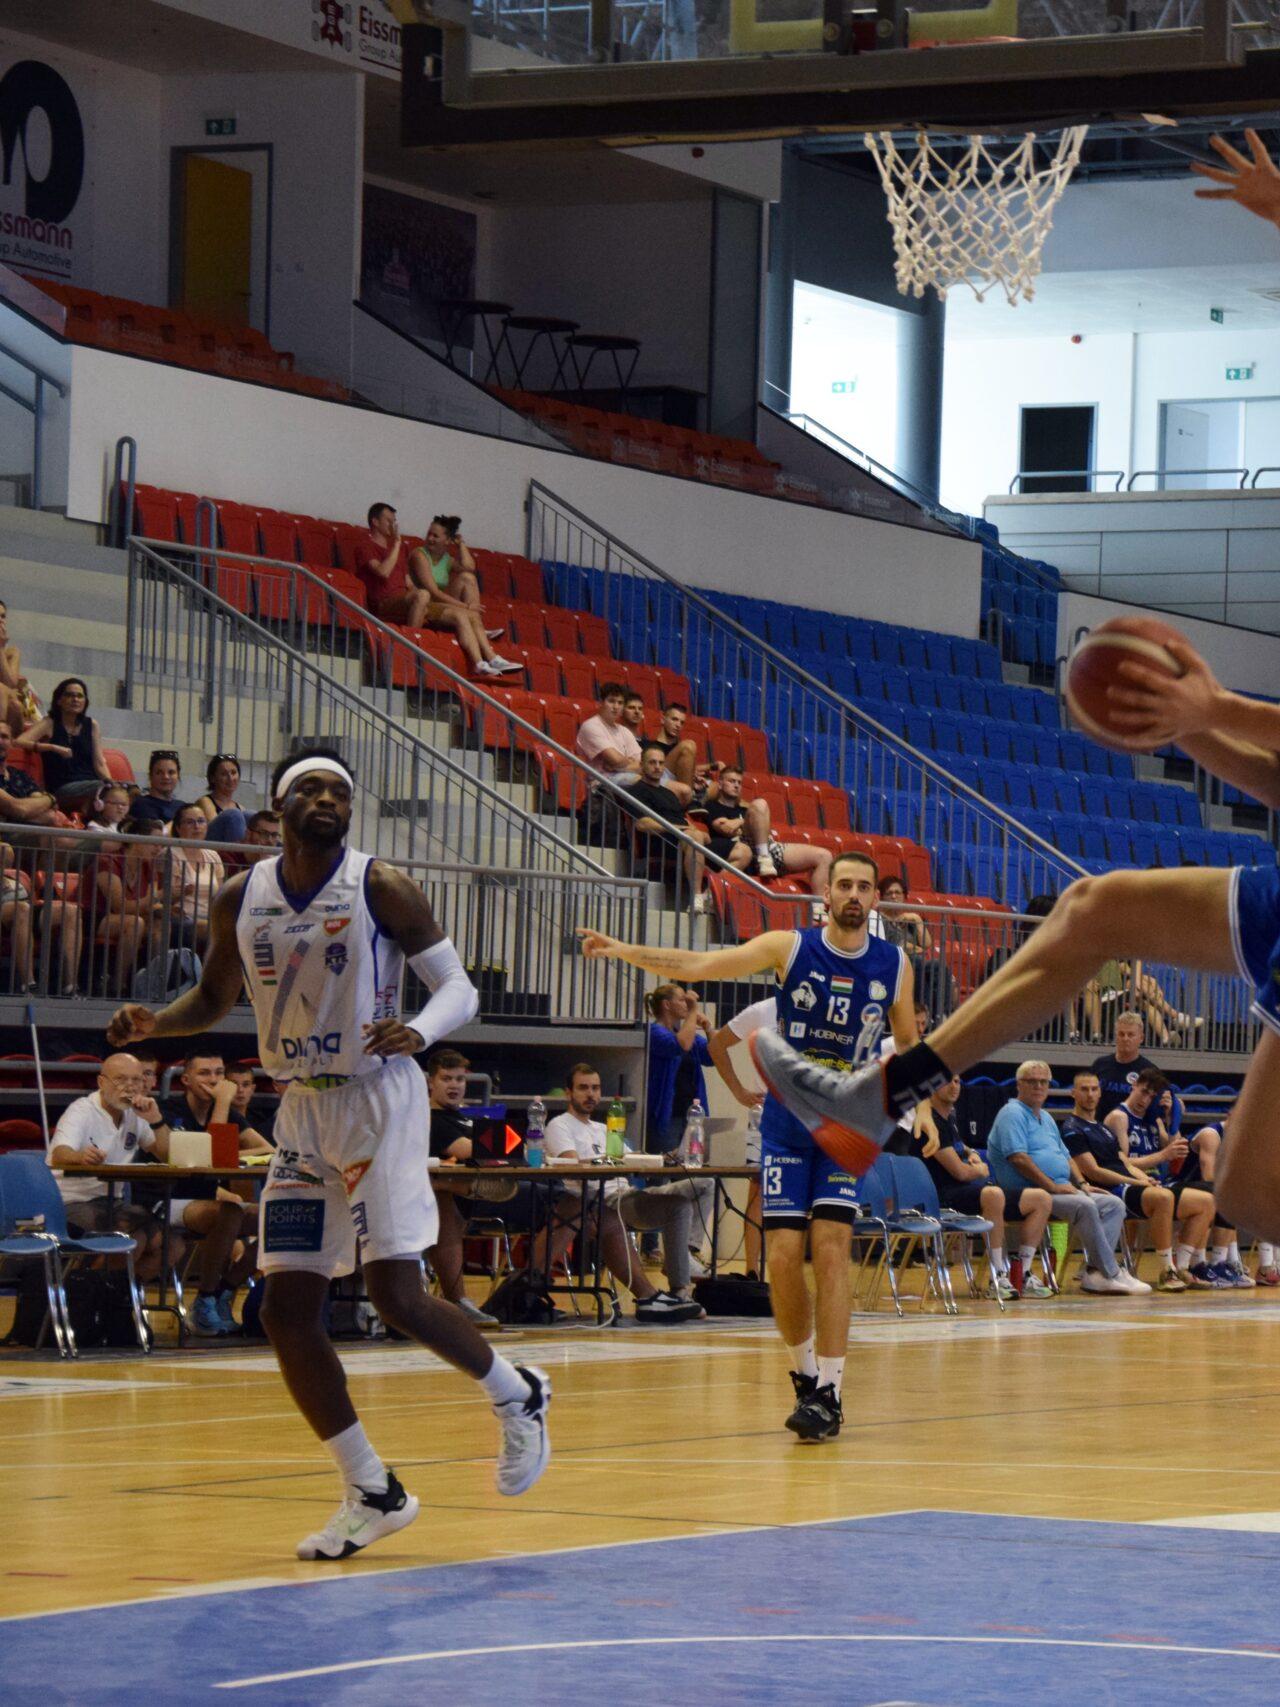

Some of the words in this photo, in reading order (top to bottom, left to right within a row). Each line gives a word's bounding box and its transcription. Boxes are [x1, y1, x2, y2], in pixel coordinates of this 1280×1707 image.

[359, 5, 402, 46] Eissm
[0, 211, 72, 250] smann
[826, 995, 851, 1026] 13
[763, 1166, 783, 1196] 13
